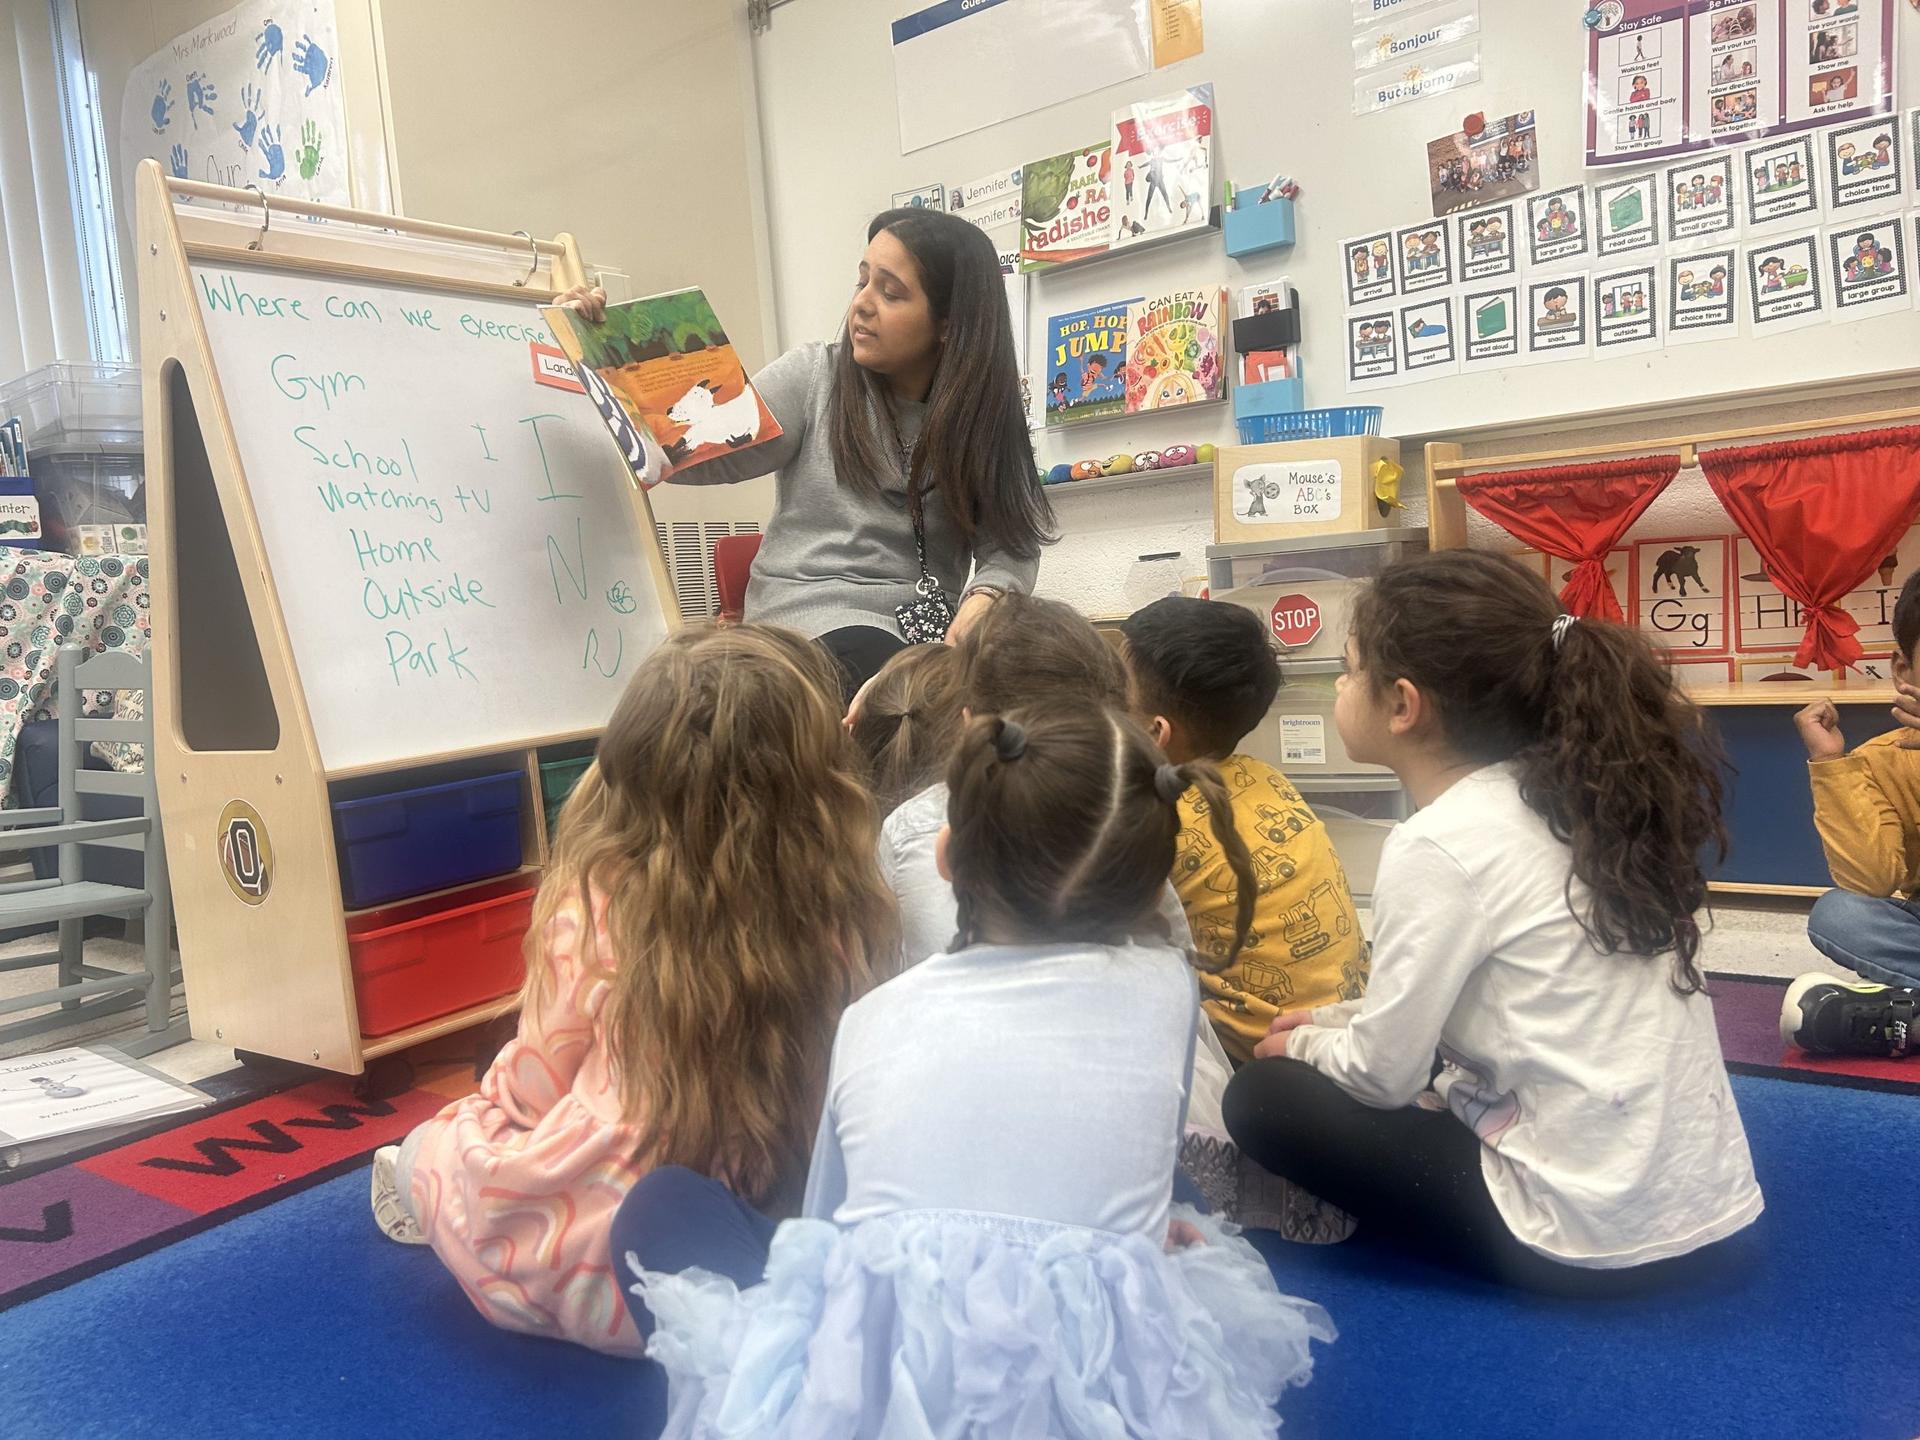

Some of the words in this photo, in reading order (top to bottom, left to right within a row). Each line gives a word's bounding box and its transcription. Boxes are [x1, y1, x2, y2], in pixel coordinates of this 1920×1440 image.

[1619, 20, 1642, 32] Stay
[1642, 15, 1662, 25] Safe
[1821, 20, 1837, 29] your
[1390, 29, 1442, 54] Bonjour
[1712, 45, 1726, 53] Wait
[1727, 42, 1743, 51] your
[1744, 39, 1757, 47] turn
[1621, 64, 1645, 74] Walking
[1646, 61, 1660, 69] feet
[1817, 62, 1836, 71] Show
[1708, 86, 1728, 95] Follow
[1729, 79, 1761, 90] directions
[1625, 104, 1645, 112] hands
[1646, 101, 1659, 109] and
[1660, 97, 1677, 106] body
[1813, 106, 1826, 114] Ask
[1826, 103, 1837, 111] for
[1838, 101, 1854, 109] help
[1728, 121, 1757, 132] together
[1614, 142, 1628, 151] Stay
[1629, 141, 1643, 149] with
[1644, 139, 1663, 147] group
[967, 178, 1009, 200] Jennifer
[1085, 187, 1108, 205] RA
[1845, 186, 1870, 198] choice
[1871, 182, 1891, 193] time
[1769, 200, 1796, 213] outside
[1027, 206, 1110, 253] radishe
[1681, 220, 1701, 232] small
[1702, 217, 1723, 230] group
[1608, 238, 1625, 248] read
[1625, 234, 1646, 245] aloud
[1540, 244, 1562, 257] large
[1562, 243, 1579, 255] group
[1473, 263, 1503, 274] breakfast
[1257, 287, 1270, 296] Omi
[1363, 287, 1383, 297] arrival
[1848, 288, 1870, 300] large
[1871, 284, 1896, 297] group
[1148, 295, 1171, 311] CAN
[1175, 291, 1194, 302] EAT
[1196, 291, 1204, 300] A
[1771, 302, 1790, 313] clean
[1791, 300, 1803, 310] up
[200, 272, 310, 321] Where
[325, 296, 383, 324] can
[400, 306, 441, 331] we
[460, 313, 556, 345] exercise
[1137, 301, 1208, 337] RAINBOW
[1680, 312, 1704, 322] choice
[1705, 310, 1722, 319] time
[1060, 320, 1090, 338] HOP,
[1613, 328, 1638, 338] outside
[1547, 334, 1566, 342] snack
[1476, 344, 1491, 353] read
[1492, 342, 1509, 351] aloud
[1423, 352, 1436, 361] rest
[1367, 364, 1382, 372] lunch
[271, 353, 366, 411] Gym
[294, 425, 419, 484] School
[1288, 471, 1336, 485] Mouse's
[1296, 487, 1331, 502] ABC's
[0, 502, 31, 515] nter
[318, 481, 443, 523] Watching
[350, 528, 441, 572] Home
[363, 573, 497, 621] Outside
[1273, 607, 1318, 632] STOP
[385, 627, 480, 687] Park
[1282, 719, 1321, 728] brightroom
[5, 1056, 78, 1074] Traditions
